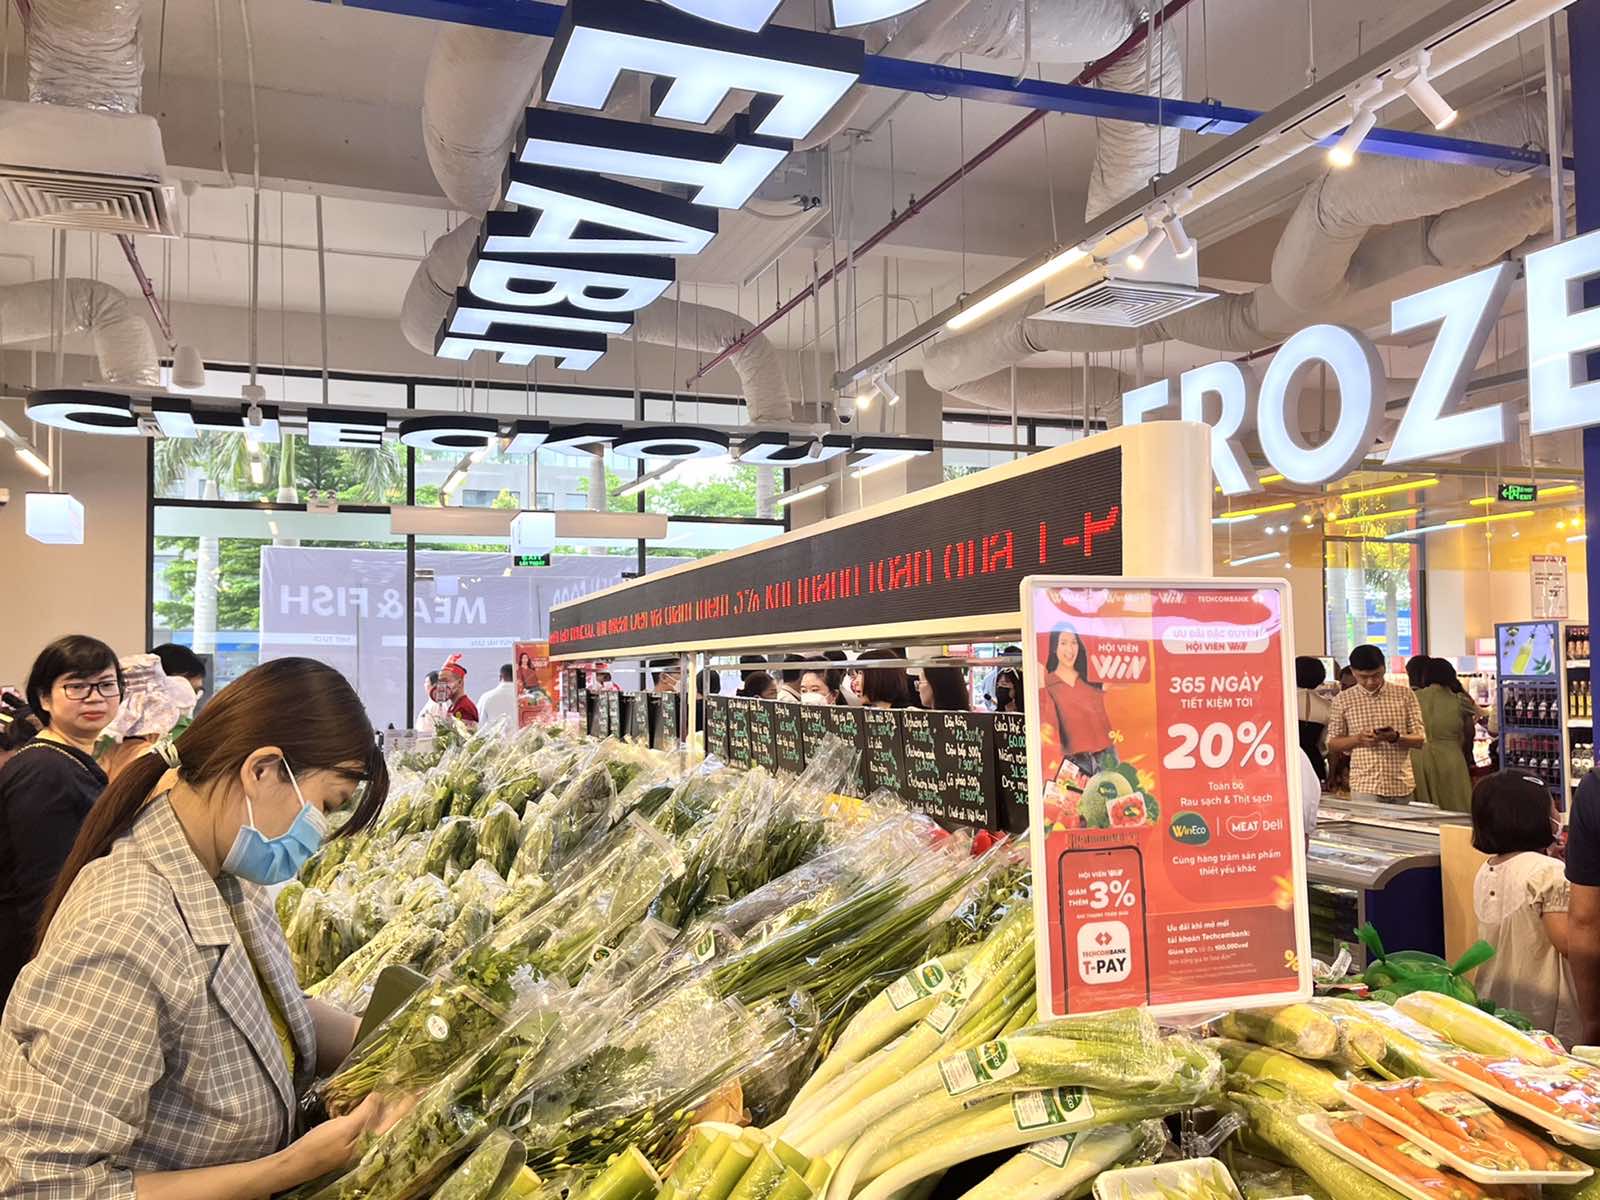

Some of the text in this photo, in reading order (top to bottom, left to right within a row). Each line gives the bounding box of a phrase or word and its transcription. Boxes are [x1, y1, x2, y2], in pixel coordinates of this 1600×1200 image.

[434, 0, 928, 374] ETABLE
[1098, 642, 1139, 653] HỘI VIÊN
[1186, 641, 1202, 652] HỘI
[1204, 641, 1225, 651] VIÊN
[1169, 671, 1263, 693] 365 NGÀY
[1180, 698, 1202, 710] TIẾT
[1206, 697, 1232, 710] KIỆM
[1163, 720, 1275, 769] 20%
[1208, 782, 1230, 791] Toàn
[1180, 794, 1273, 807] Rau sạch & Thịt sạch
[1232, 822, 1258, 832] MEAT
[1172, 848, 1281, 866] Cùng hàng trăm sản phẩm
[1200, 864, 1257, 878] thiết yếu khác
[1088, 880, 1136, 909] 3%
[1192, 921, 1202, 930] khi
[1178, 934, 1200, 943] khoản
[1082, 948, 1127, 958] TECHCOMBANK
[1082, 957, 1126, 975] T-PAY
